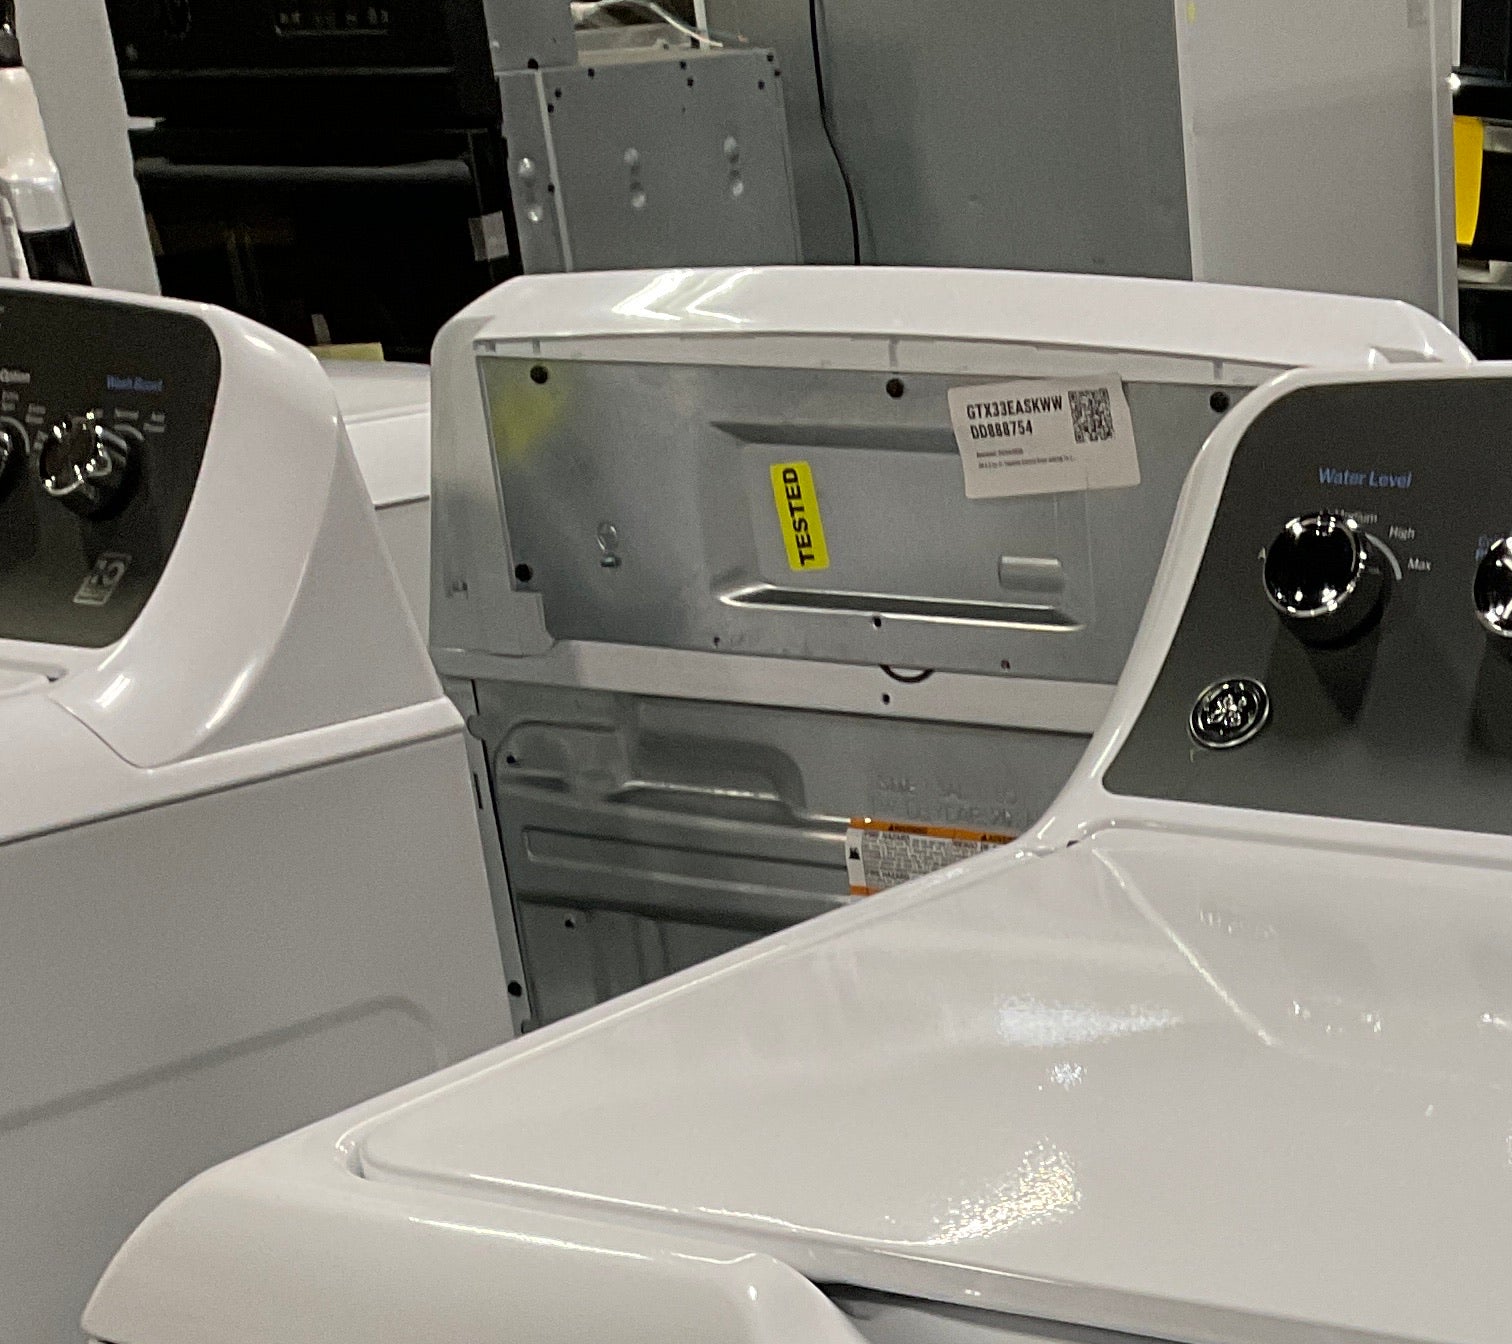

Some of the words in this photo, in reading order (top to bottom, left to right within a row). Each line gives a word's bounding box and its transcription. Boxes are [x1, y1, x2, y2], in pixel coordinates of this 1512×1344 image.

[967, 395, 1063, 420] GTX33EASKWW
[1319, 467, 1367, 486] Water
[1369, 471, 1413, 489] Level
[782, 467, 816, 567] TESTED
[1388, 525, 1416, 541] High
[1407, 556, 1432, 572] Max
